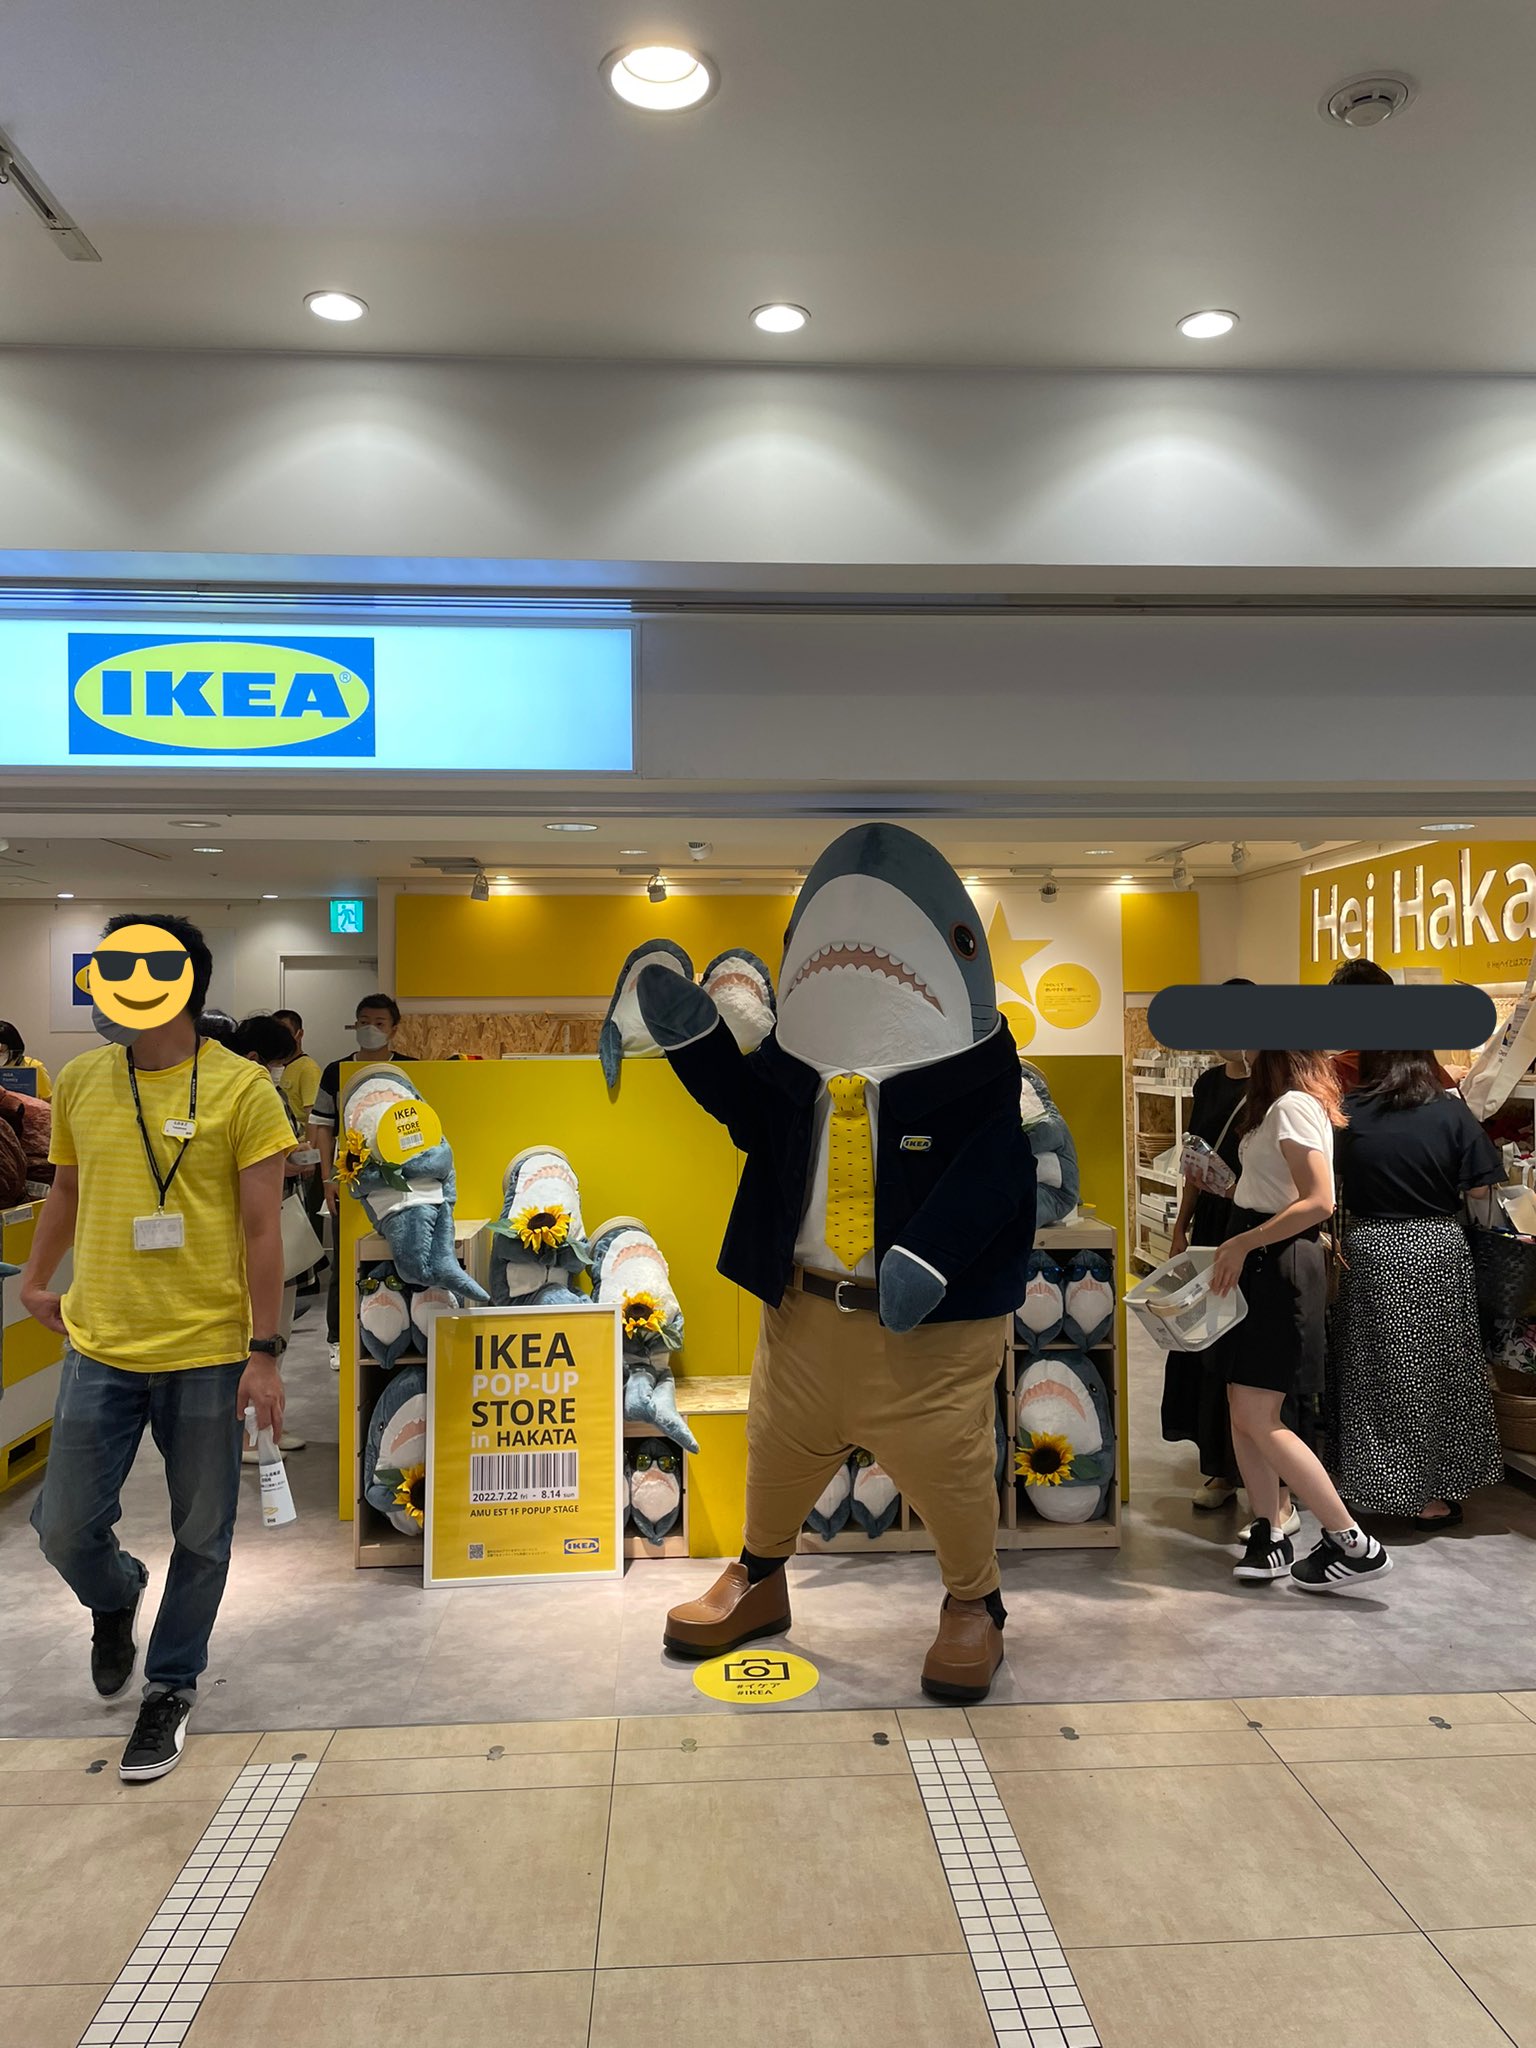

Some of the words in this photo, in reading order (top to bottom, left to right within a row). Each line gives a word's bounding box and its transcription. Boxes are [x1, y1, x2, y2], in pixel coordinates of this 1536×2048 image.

[101, 669, 350, 718] IKEA
[1312, 872, 1375, 963] Hej
[1392, 848, 1536, 954] Haka
[394, 1106, 417, 1120] IKEA
[396, 1120, 420, 1133] STORE
[474, 1332, 576, 1370] IKEA
[472, 1371, 579, 1397] POP-UP
[471, 1398, 576, 1427] STORE
[471, 1431, 490, 1449] in
[497, 1428, 577, 1447] HAKATA
[472, 1491, 518, 1502] 2022.7.22
[541, 1490, 560, 1499] 8.14
[470, 1509, 491, 1517] AMU
[493, 1507, 508, 1516] EST
[510, 1507, 520, 1516] 1F
[521, 1506, 551, 1515] POPUP
[553, 1504, 579, 1514] STAGE
[567, 1542, 597, 1550] IKEA
